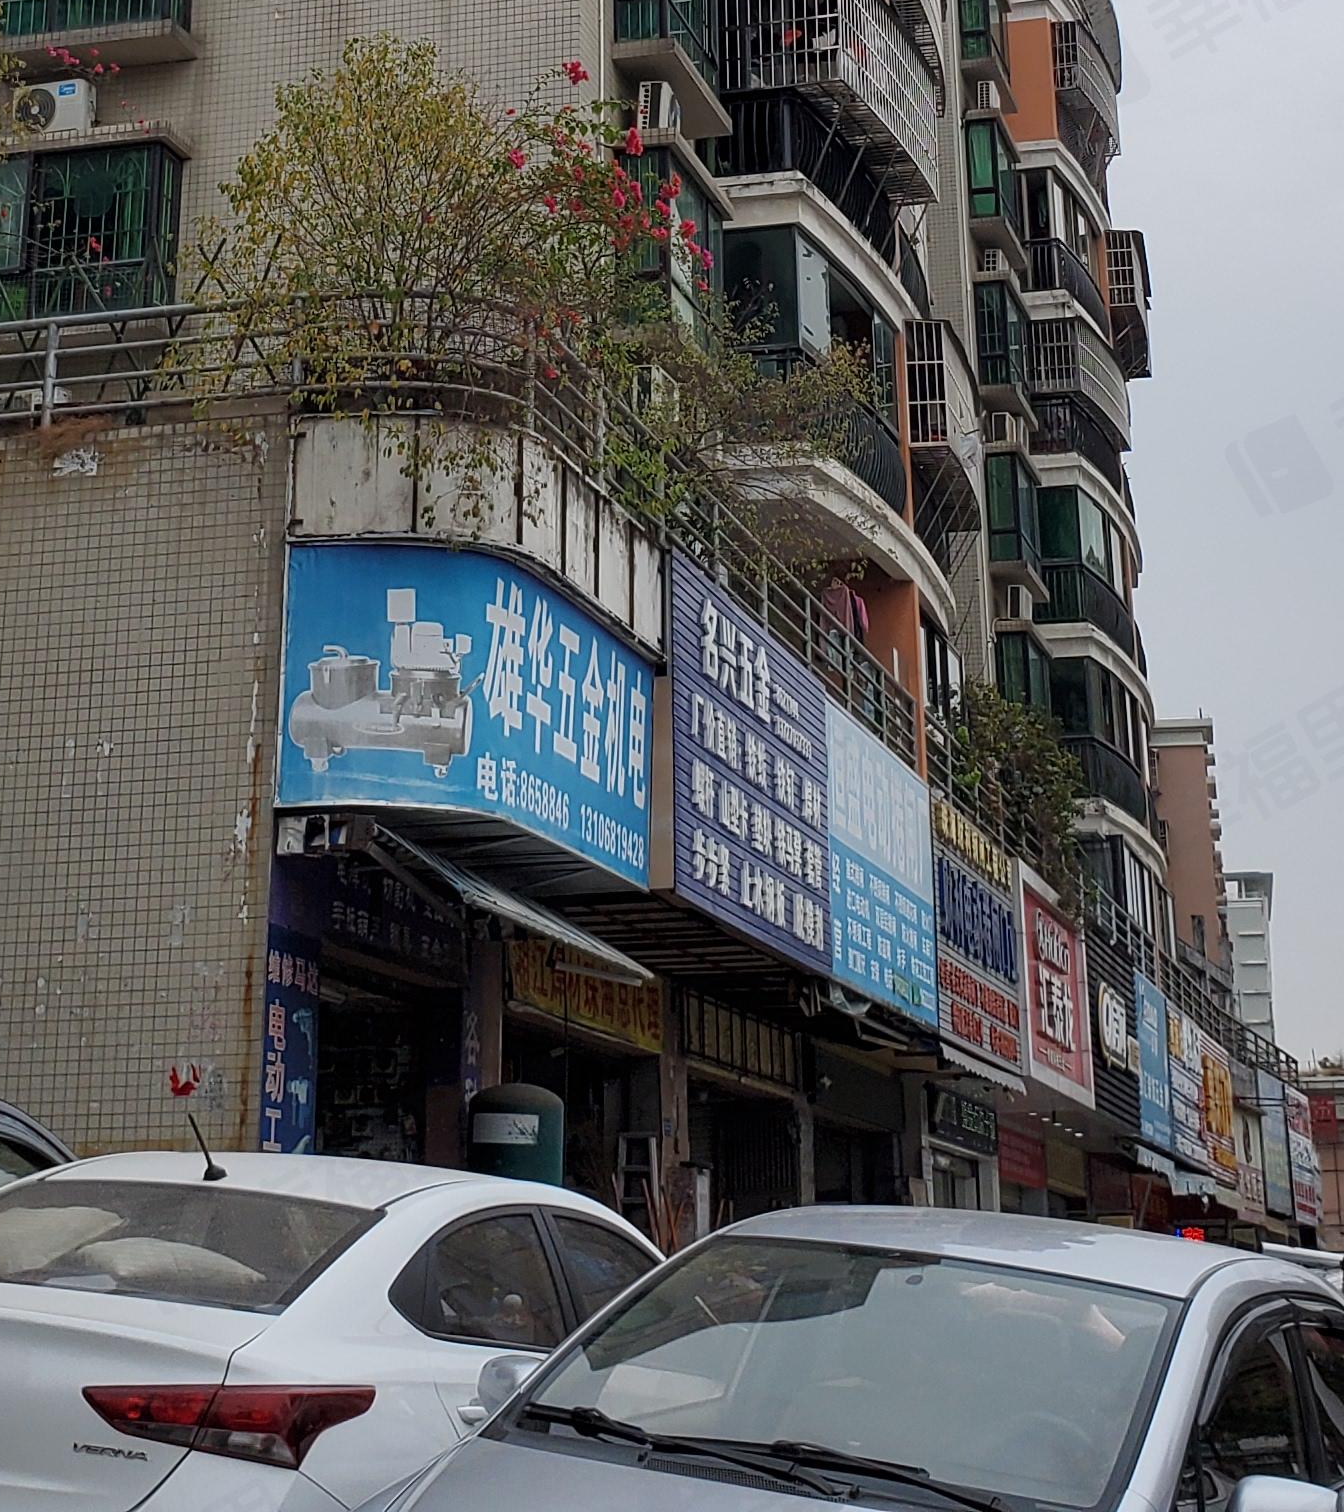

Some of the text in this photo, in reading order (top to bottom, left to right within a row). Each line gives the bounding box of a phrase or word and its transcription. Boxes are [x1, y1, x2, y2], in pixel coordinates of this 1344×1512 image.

[483, 577, 646, 810] 雄华五金机电
[700, 594, 771, 727] 名兴五金
[268, 949, 319, 996] 维修马达
[1038, 961, 1076, 1052] 汇泰龙
[72, 1442, 149, 1462] VERNA
